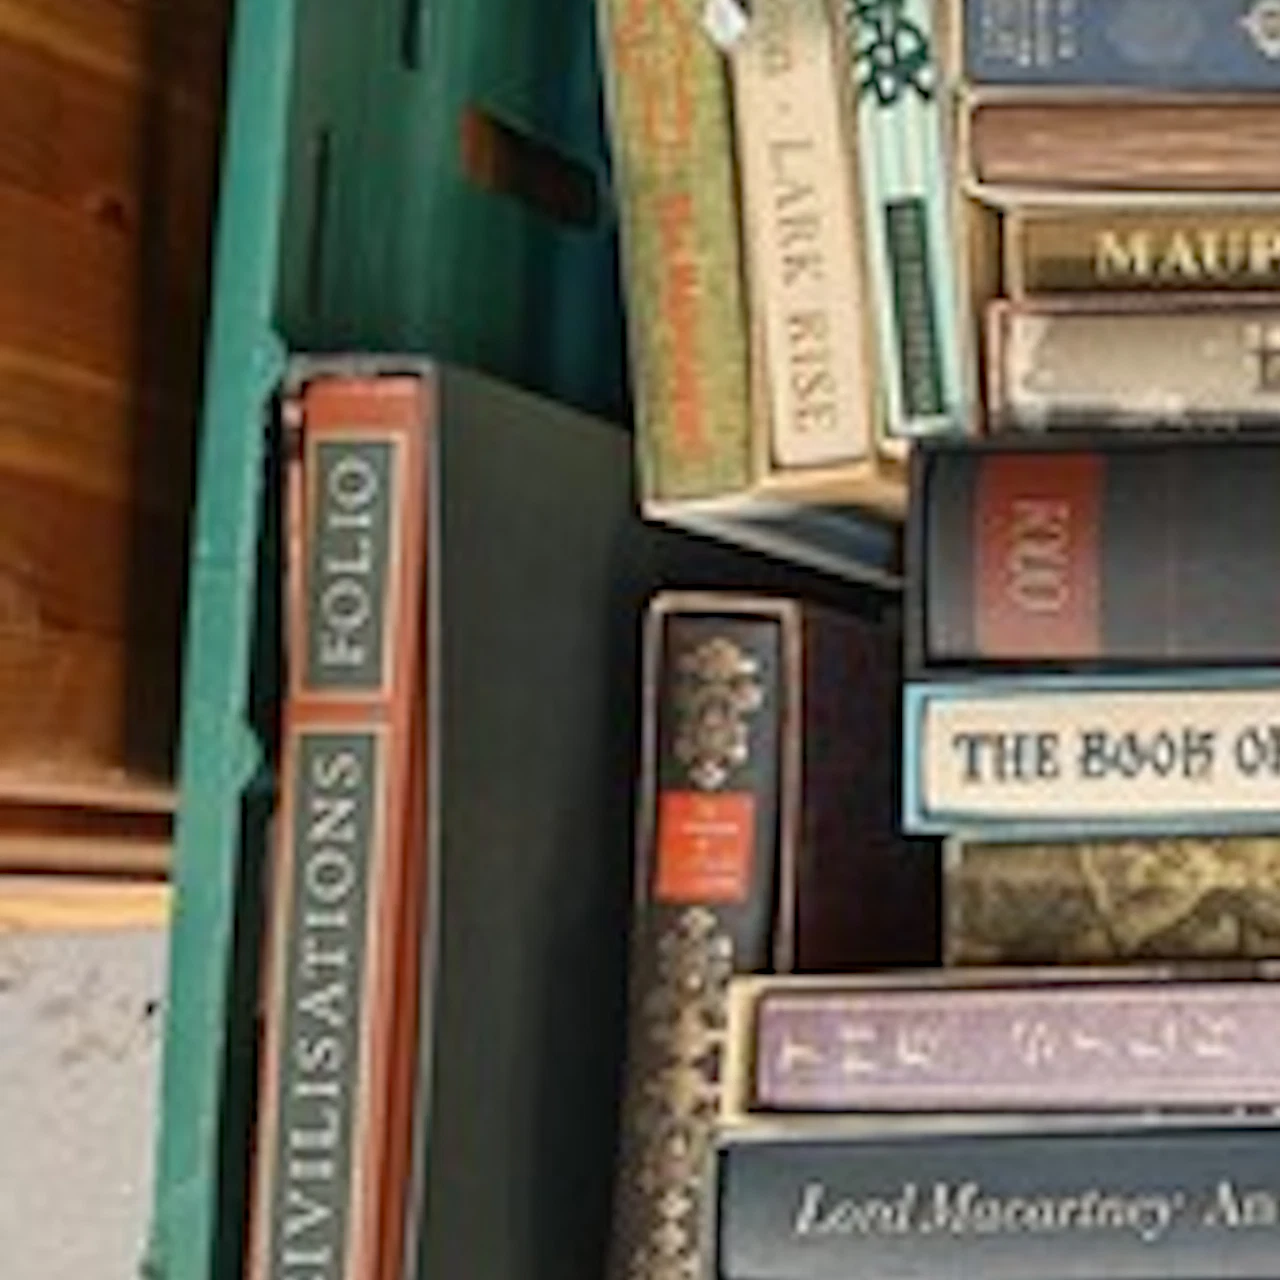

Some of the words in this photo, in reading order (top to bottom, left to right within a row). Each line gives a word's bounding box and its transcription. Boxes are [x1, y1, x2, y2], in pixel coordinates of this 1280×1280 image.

[768, 137, 823, 287] LARK
[786, 318, 840, 438] RISE
[319, 453, 379, 668] FOLIO
[953, 732, 1062, 784] THE
[1076, 728, 1219, 781] BOOK
[796, 1181, 917, 1237] Lord
[919, 1183, 1172, 1243] Macartney
[1204, 1180, 1277, 1228] An
